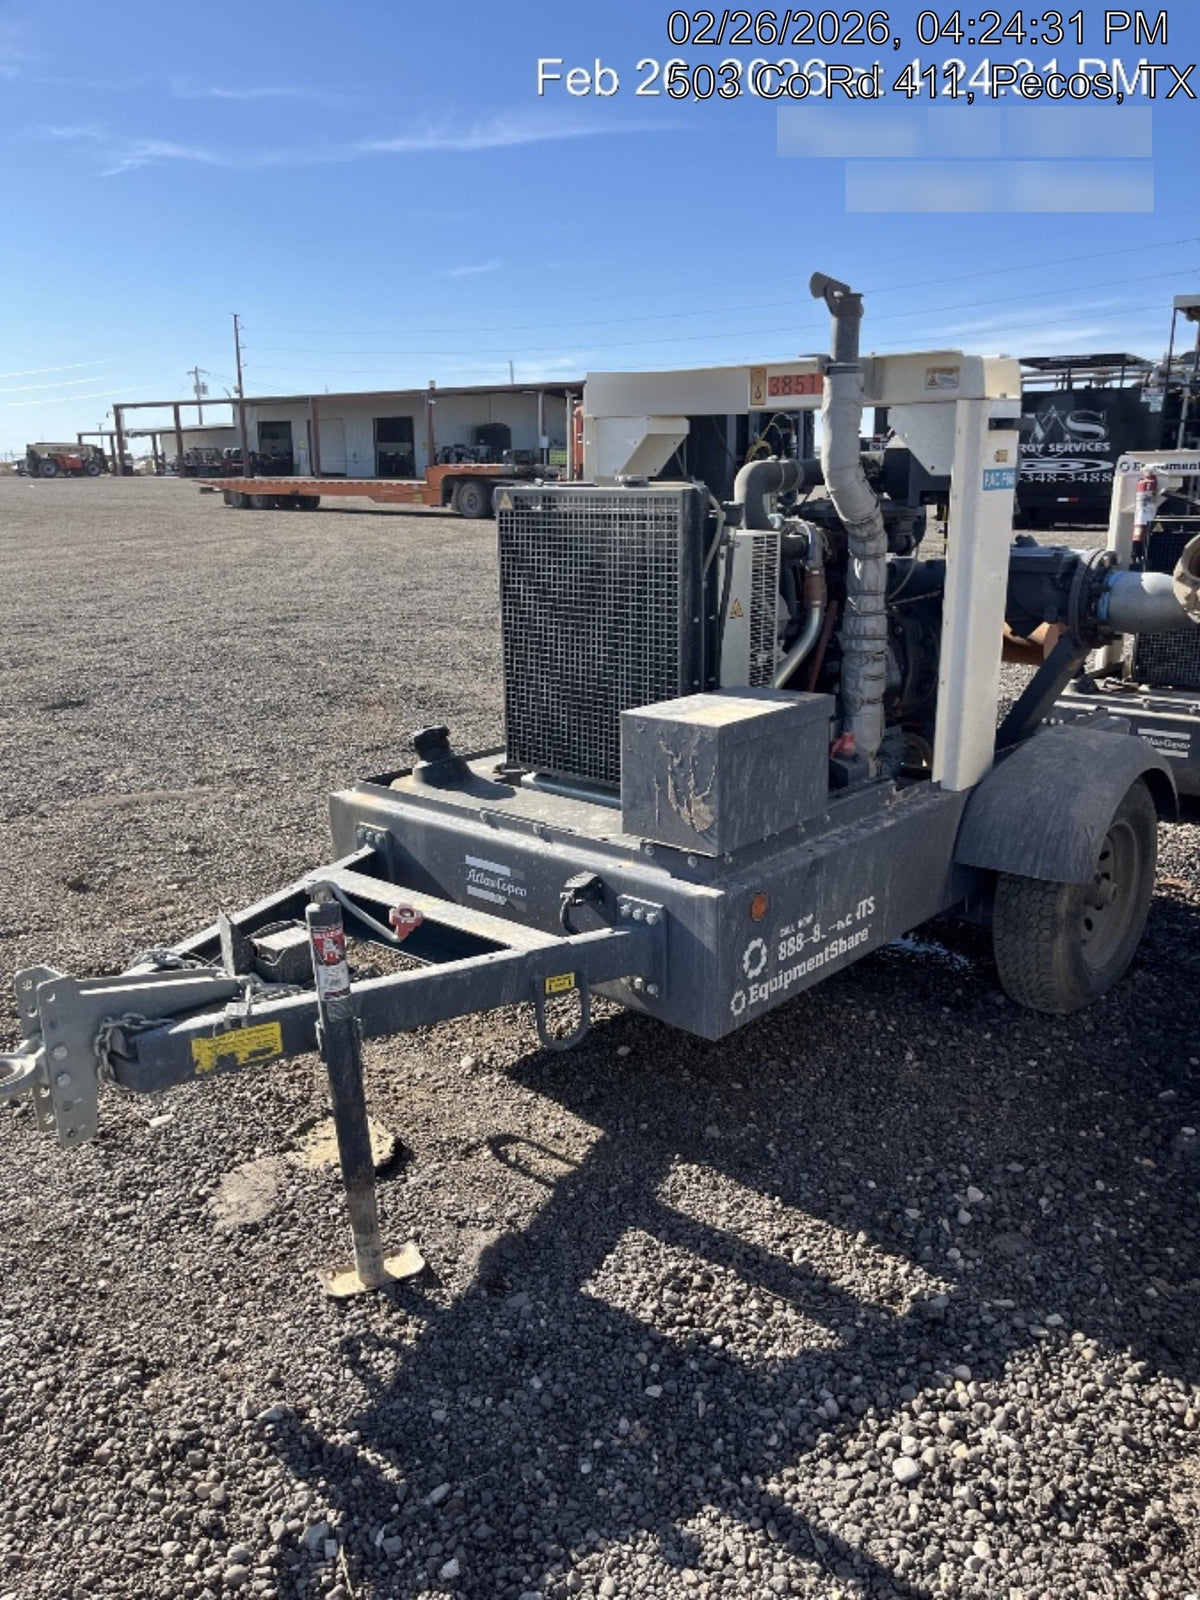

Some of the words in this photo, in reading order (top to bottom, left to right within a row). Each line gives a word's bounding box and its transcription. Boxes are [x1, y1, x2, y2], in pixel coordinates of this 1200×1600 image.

[1048, 442, 1111, 453] SERVICES
[466, 868, 497, 889] Atlas
[497, 877, 528, 897] Copco
[748, 926, 869, 1006] EquipmentShare
